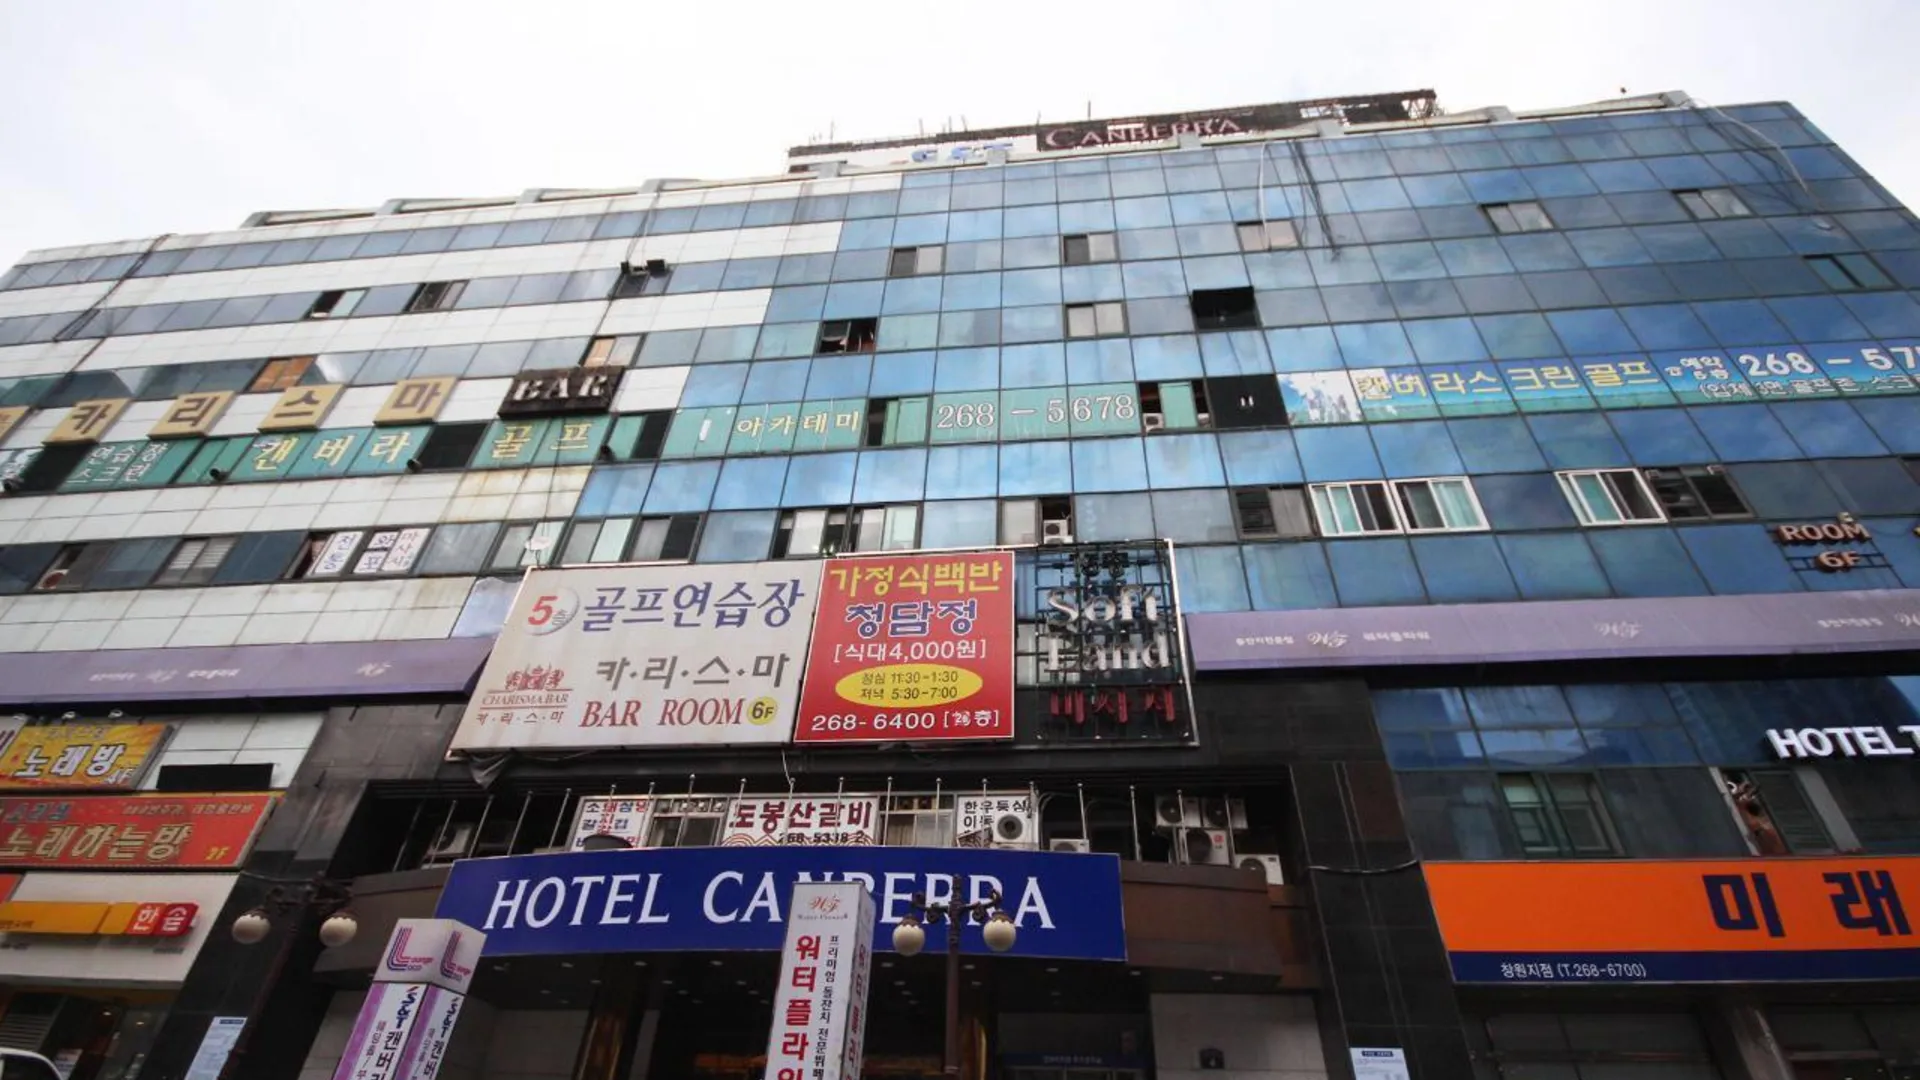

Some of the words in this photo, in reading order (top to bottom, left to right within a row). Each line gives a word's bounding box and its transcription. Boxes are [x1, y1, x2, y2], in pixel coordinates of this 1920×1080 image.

[1045, 118, 1241, 148] CANBERRA
[1739, 352, 1815, 377] 268
[1861, 347, 1920, 372] 57
[513, 371, 609, 401] BAR
[254, 432, 411, 471] 캔버라
[492, 422, 593, 459] 골프
[737, 409, 860, 438] 아카데미
[937, 402, 994, 429] 268
[1047, 394, 1136, 424] 5678
[1779, 523, 1870, 542] ROOM
[1819, 550, 1861, 568] 6F
[829, 561, 1003, 597] 가정식백반
[582, 579, 805, 632] 골프연습장
[844, 598, 979, 639] 청담정
[891, 687, 957, 700] 5:30-7:00
[579, 700, 641, 727] BAR
[658, 698, 745, 726] ROOM
[752, 702, 774, 720] 6F
[1765, 726, 1914, 760] HOTEL
[12, 743, 127, 778] 노래방
[729, 801, 872, 834] 도봉산갈비
[0, 823, 195, 862] 노래하는방
[482, 873, 670, 930] HOTEL
[1501, 962, 1554, 978] 창원지점
[1557, 962, 1647, 979] (T.268-6700)
